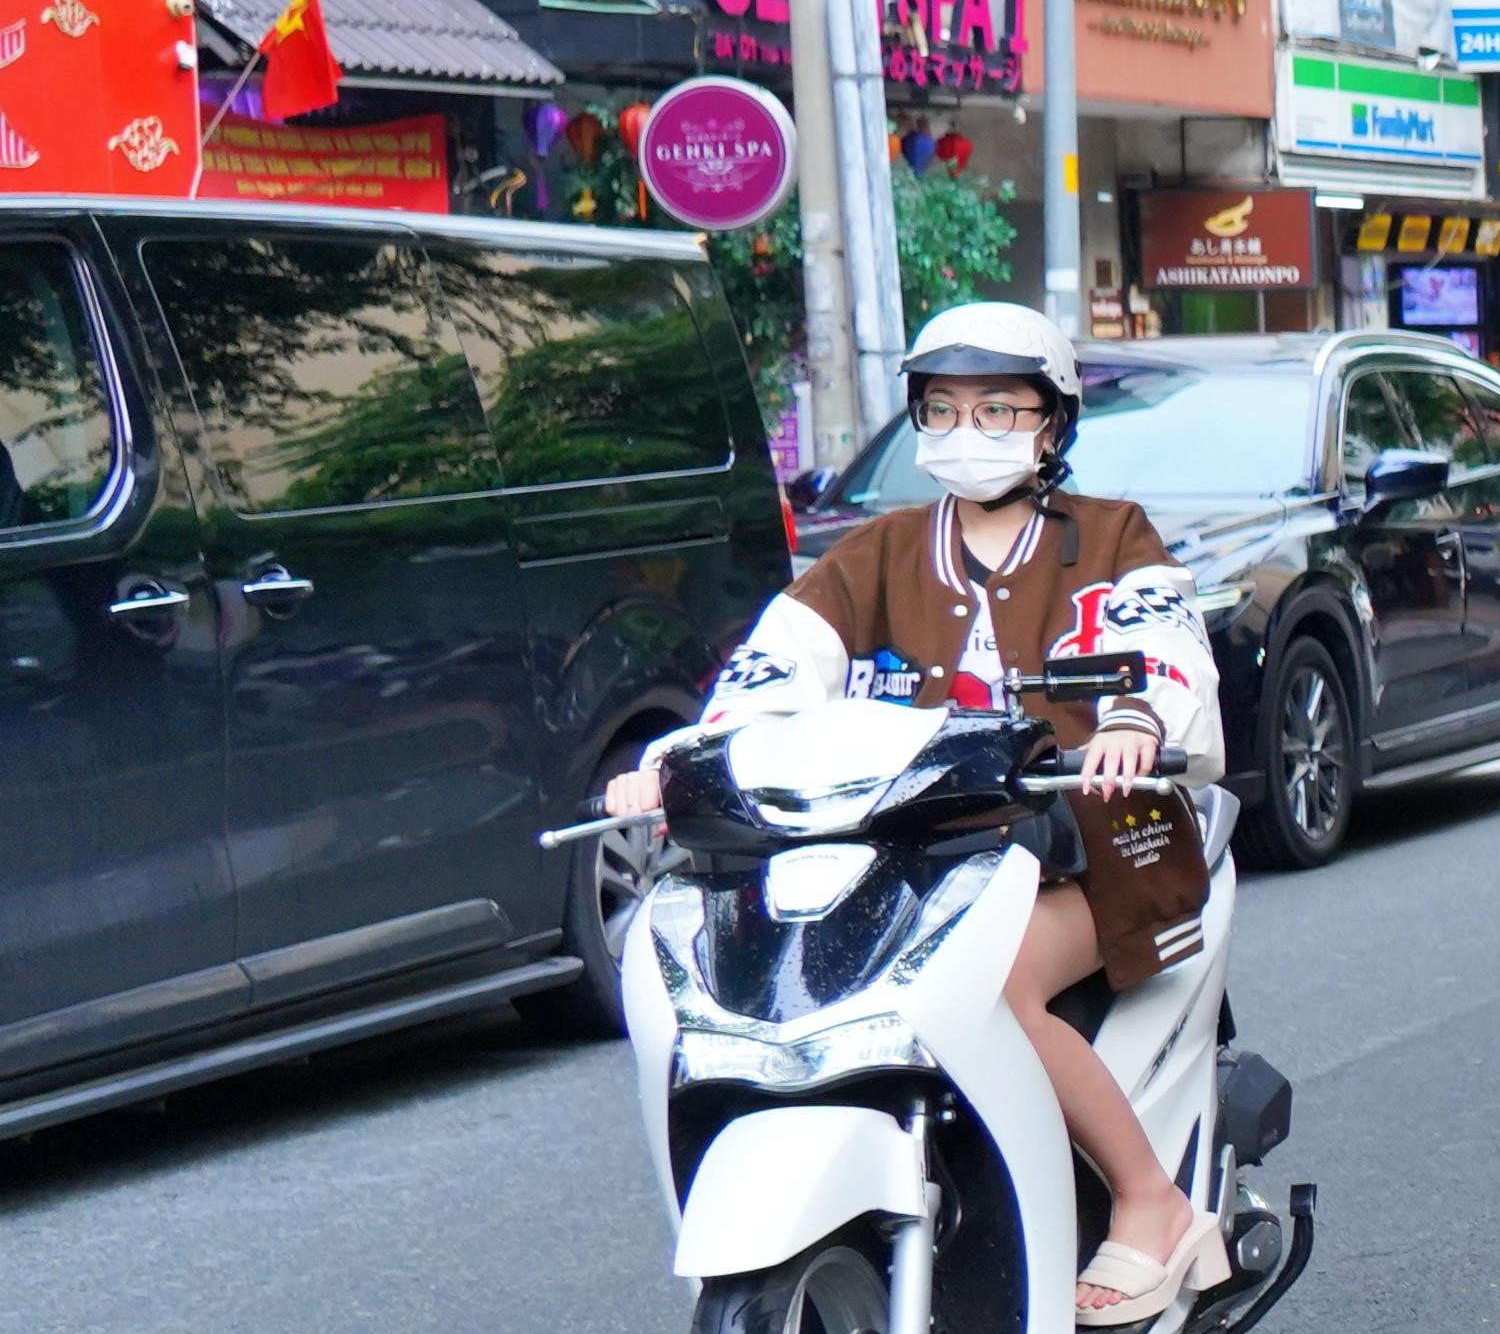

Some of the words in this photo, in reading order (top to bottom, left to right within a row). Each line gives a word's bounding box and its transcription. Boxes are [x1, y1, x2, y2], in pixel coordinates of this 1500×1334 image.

[1461, 32, 1500, 53] 24H
[1371, 104, 1435, 145] FamilyMart
[656, 141, 725, 161] GENKI
[734, 139, 773, 158] SPA
[1156, 266, 1300, 285] ASHIKATAHONPO
